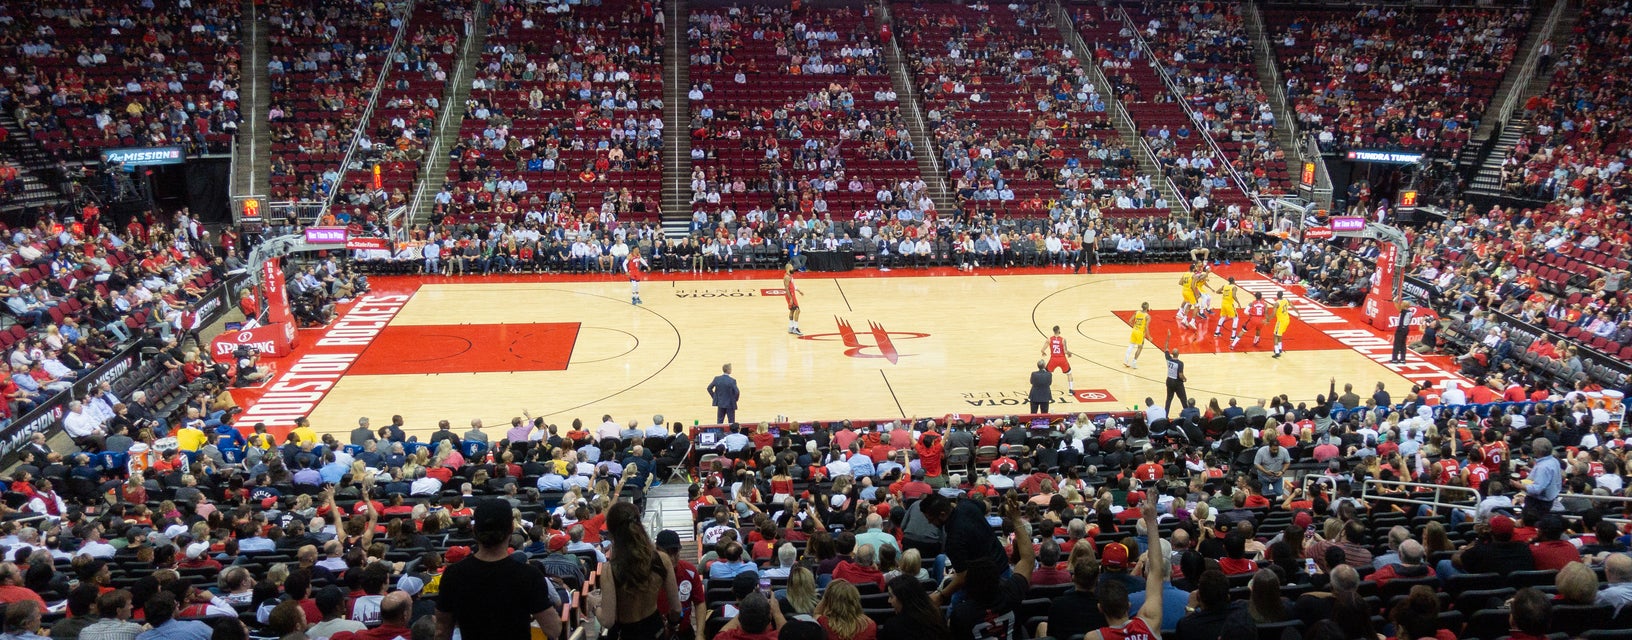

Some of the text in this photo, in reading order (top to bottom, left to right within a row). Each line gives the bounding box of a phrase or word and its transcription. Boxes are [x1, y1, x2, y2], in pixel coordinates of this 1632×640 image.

[1391, 154, 1421, 162] TUNNE
[315, 294, 409, 347] ROCKETS
[216, 340, 276, 355] SPAING
[233, 353, 359, 427] HOUSTON
[960, 390, 1065, 398] CNTER
